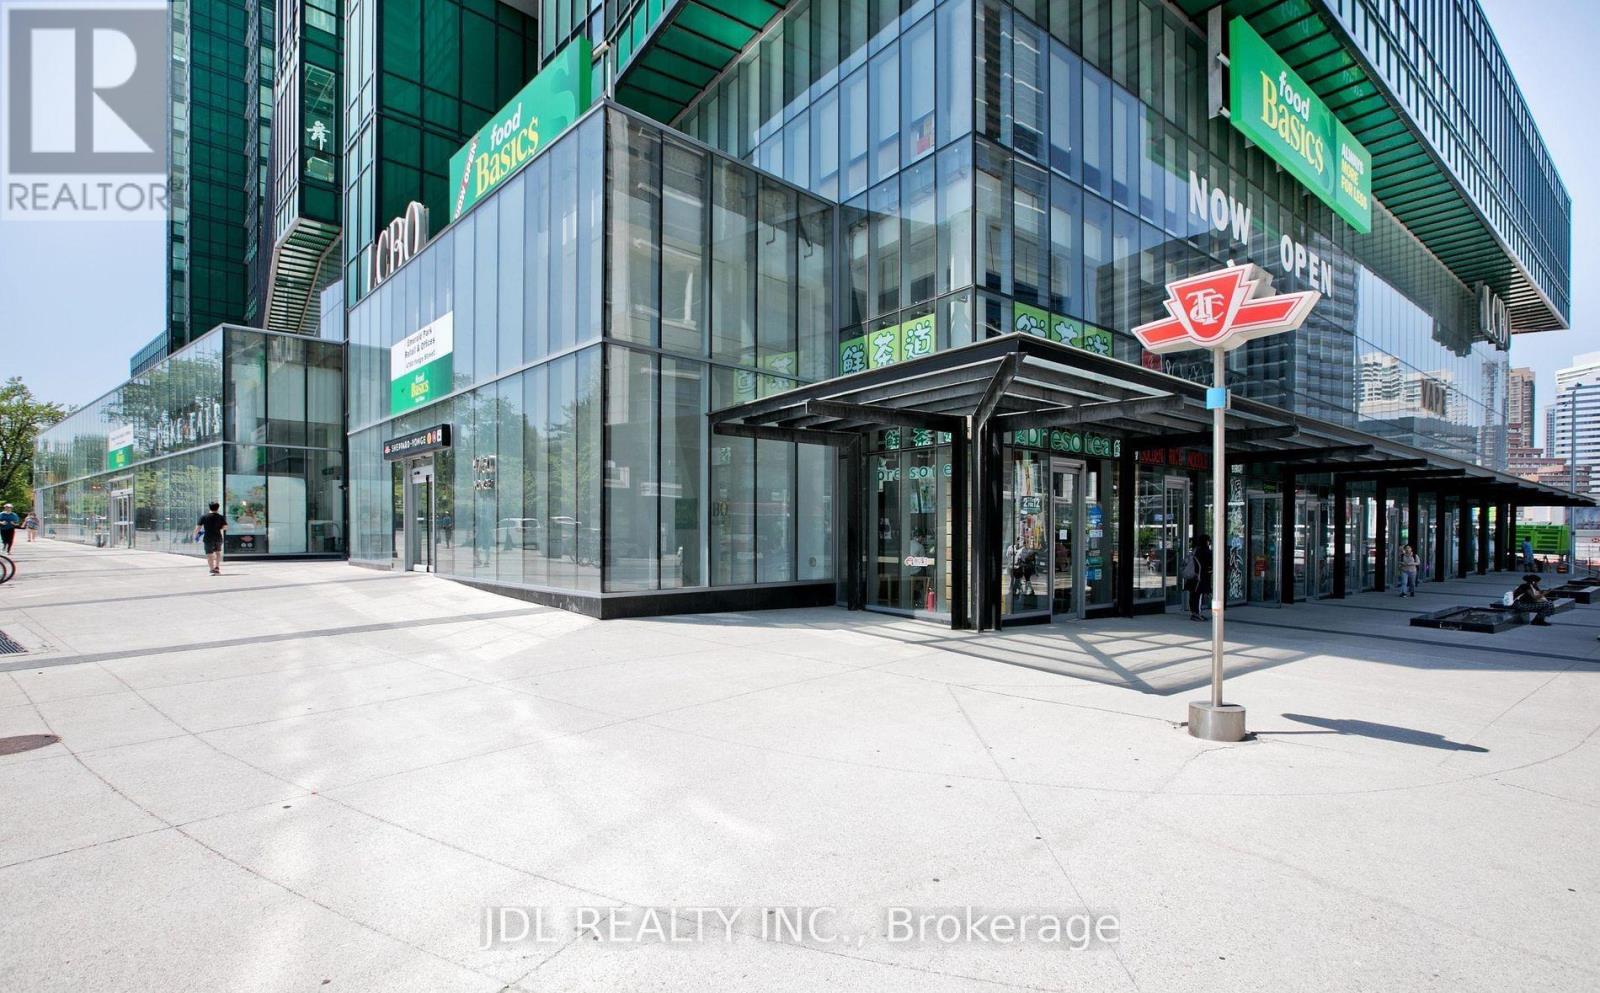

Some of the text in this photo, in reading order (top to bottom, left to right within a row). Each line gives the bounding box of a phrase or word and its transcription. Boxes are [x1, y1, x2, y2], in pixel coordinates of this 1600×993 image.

[1279, 71, 1311, 122] food
[490, 103, 522, 151] food
[1189, 170, 1251, 246] NOW
[1280, 234, 1332, 298] OPEN
